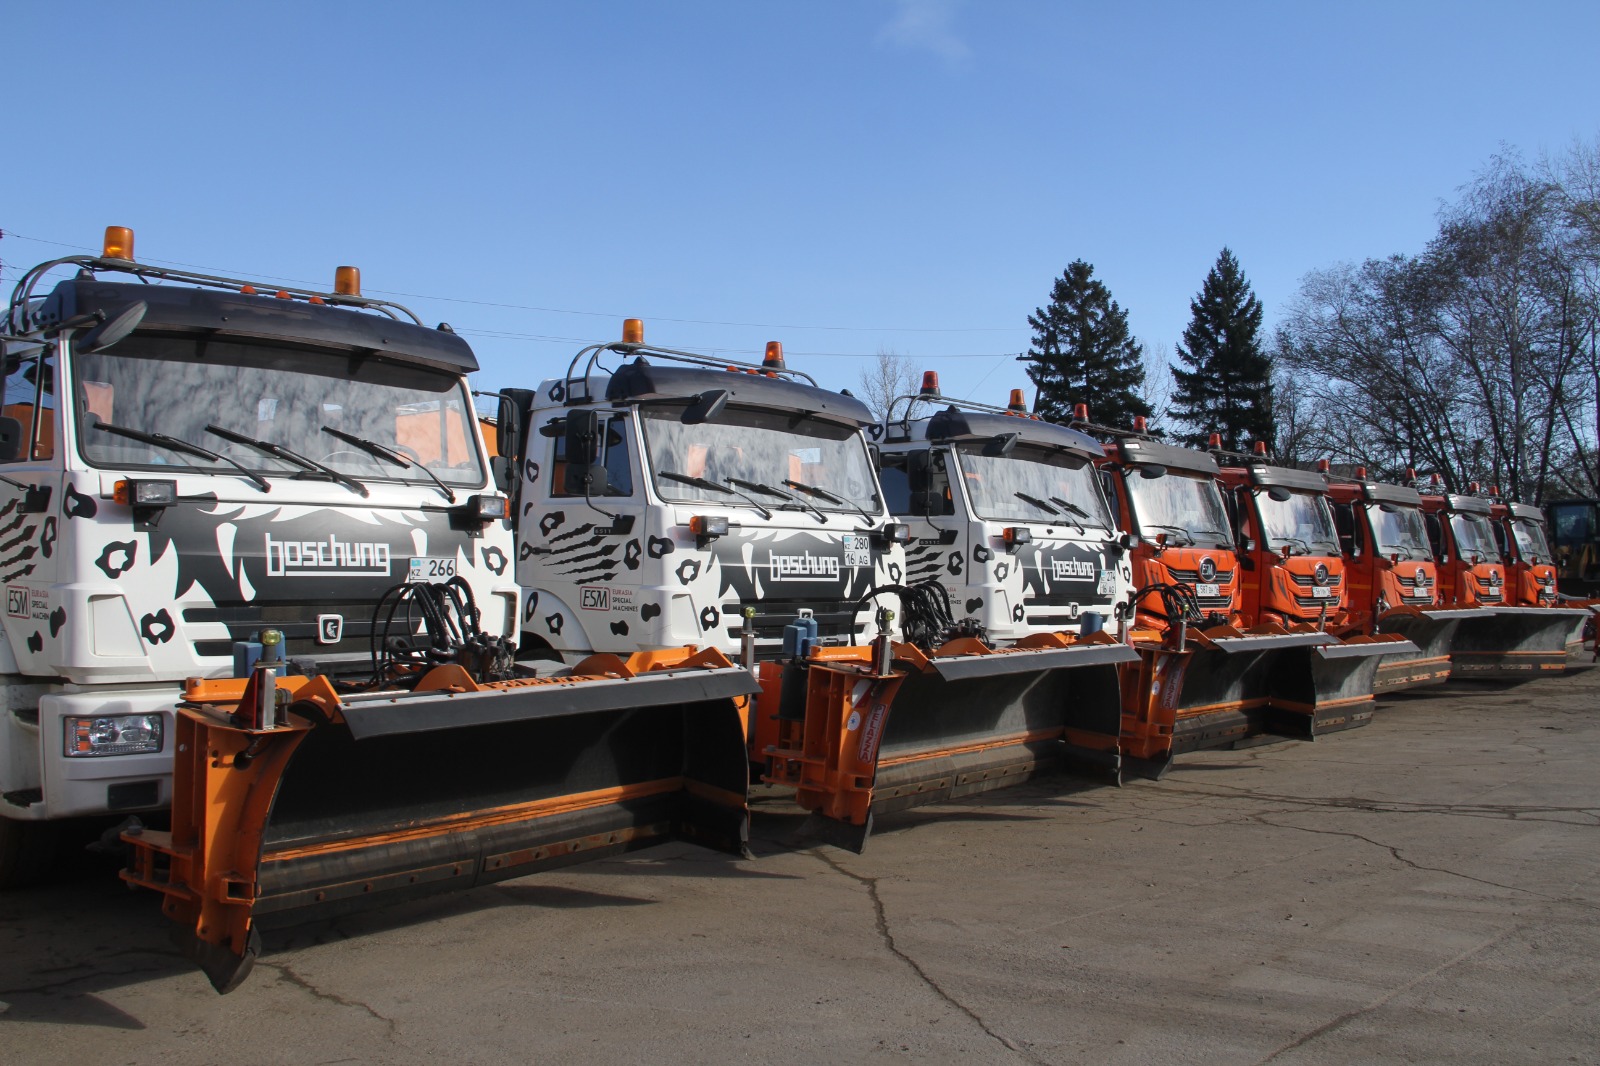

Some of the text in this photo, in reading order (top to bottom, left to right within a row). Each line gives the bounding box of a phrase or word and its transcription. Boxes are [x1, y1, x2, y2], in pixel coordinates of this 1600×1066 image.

[854, 537, 869, 550] 280
[265, 532, 391, 577] boschung
[845, 553, 869, 565] 16 AG
[411, 568, 421, 577] KZ
[428, 559, 454, 577] 266
[769, 549, 840, 582] boschung
[1050, 555, 1095, 582] boschung
[582, 589, 608, 609] ESM
[612, 588, 633, 596] EURASIA
[612, 596, 632, 604] SPECIAL
[8, 589, 29, 615] ESM
